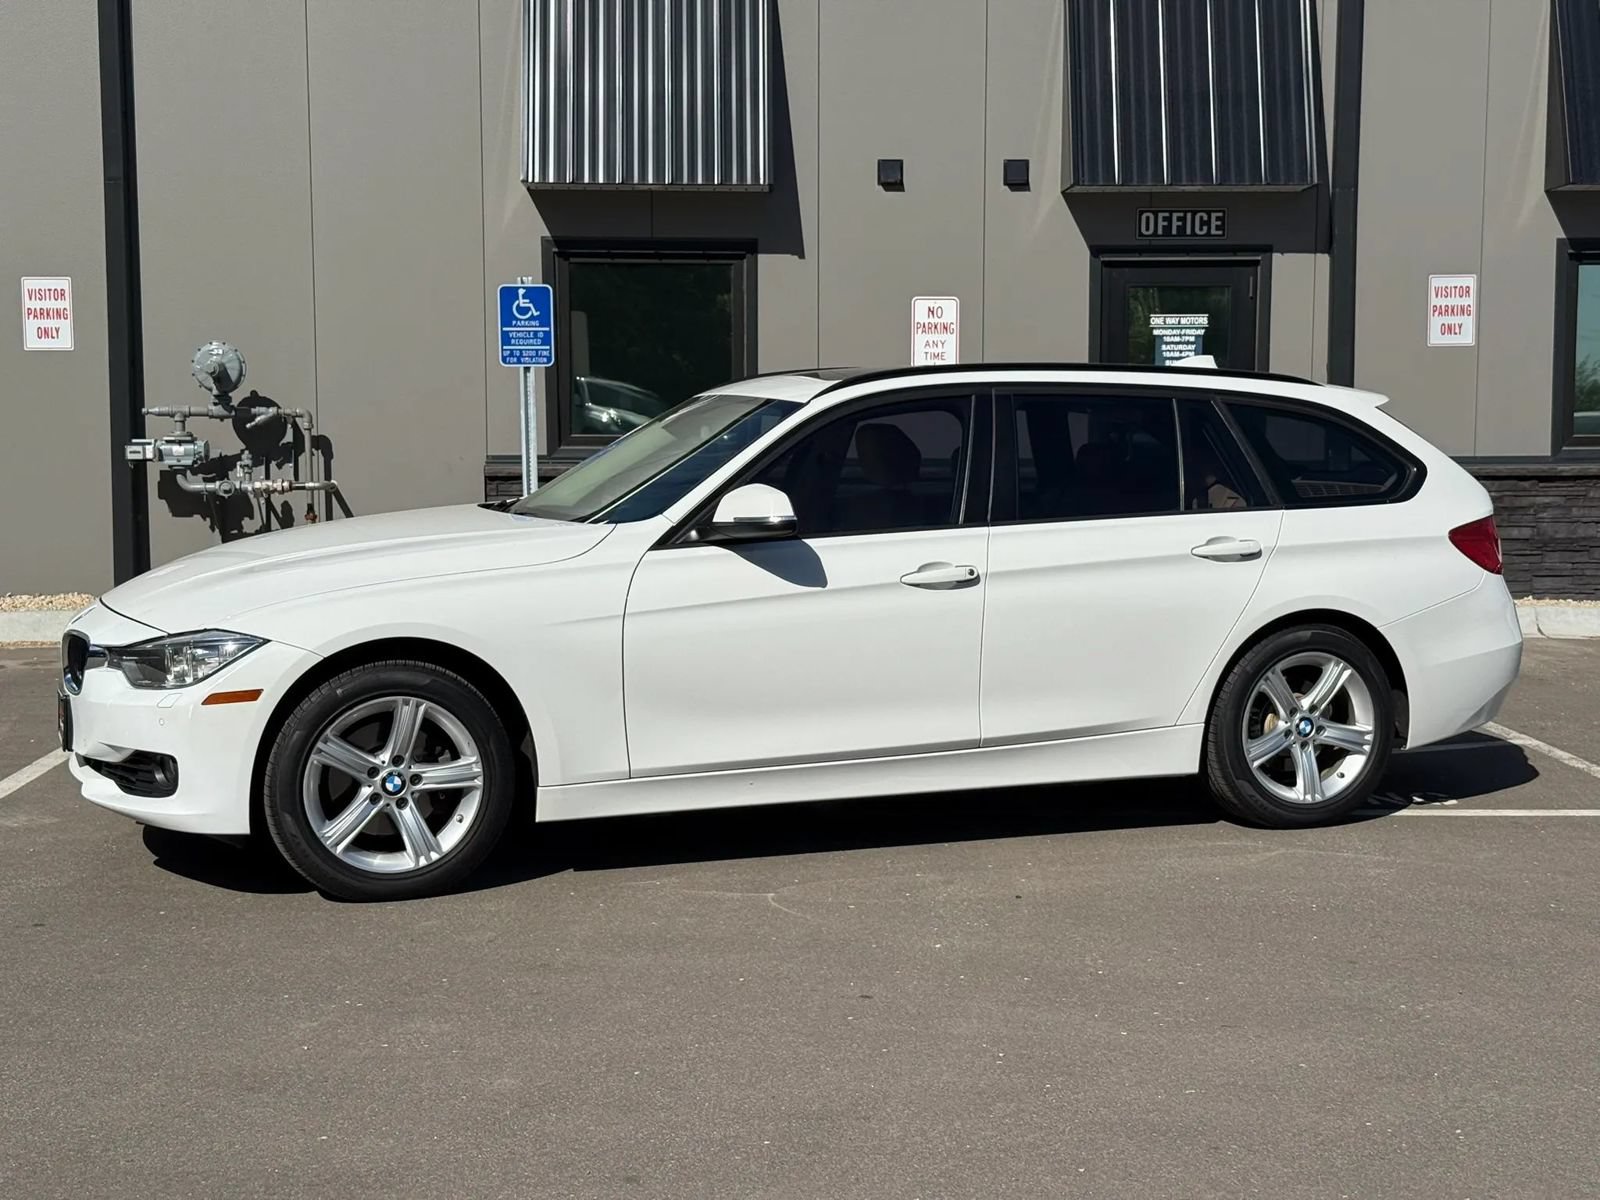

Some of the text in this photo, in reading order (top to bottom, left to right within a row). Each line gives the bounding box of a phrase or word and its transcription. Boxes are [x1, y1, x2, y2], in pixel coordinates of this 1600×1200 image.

[1141, 212, 1223, 235] OFFICE
[27, 288, 66, 301] VISITOR
[1434, 285, 1471, 298] VISITOR
[27, 307, 69, 320] PARKING
[927, 306, 944, 319] NO
[1432, 304, 1472, 317] PARKING
[1150, 317, 1208, 325] ONE WAY MOTORS
[36, 326, 60, 339] ONLY
[916, 322, 955, 335] PARKING
[1440, 322, 1463, 336] ONLY
[924, 339, 947, 349] ANY
[923, 352, 947, 361] TIME
